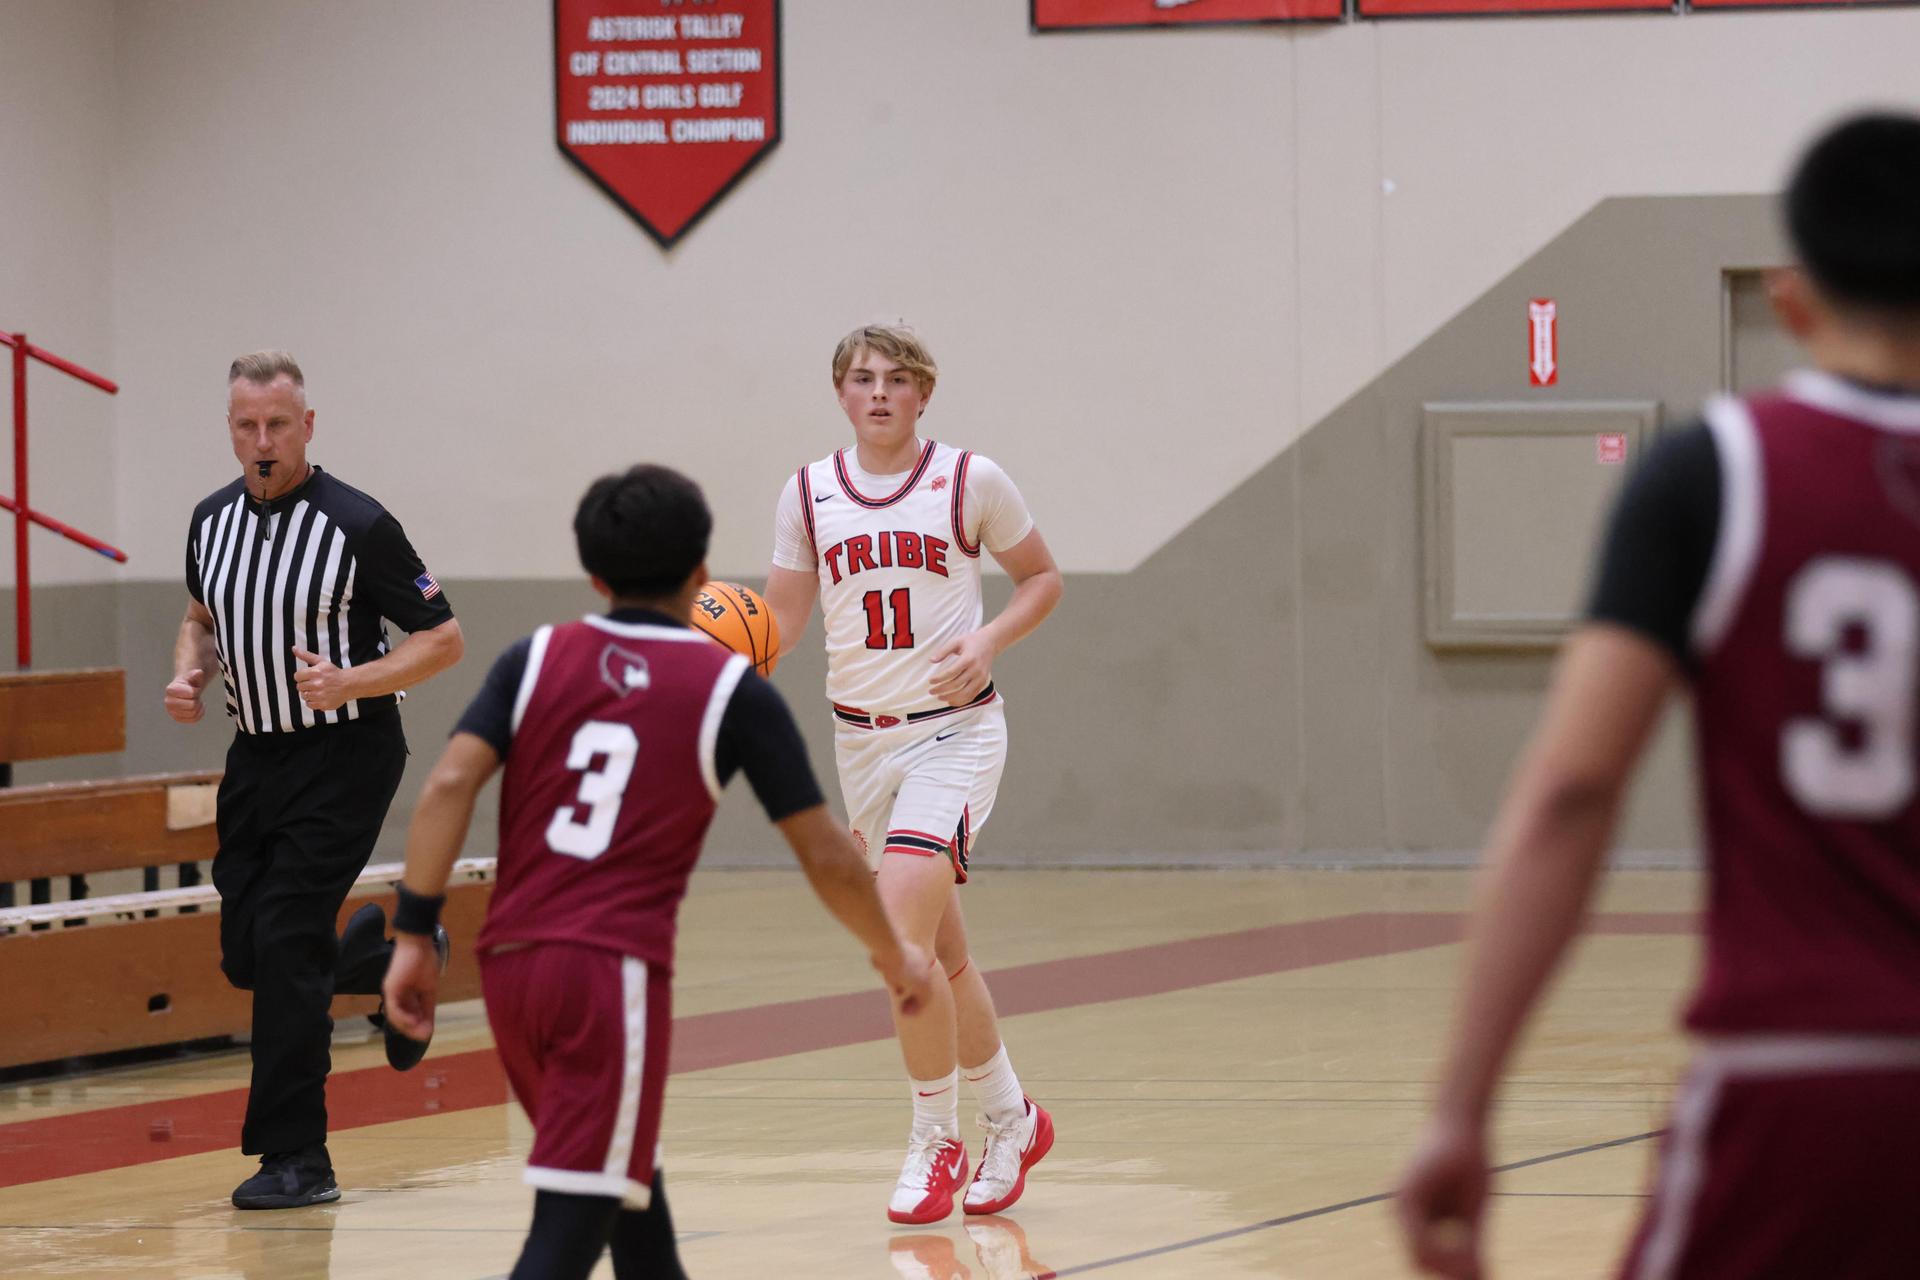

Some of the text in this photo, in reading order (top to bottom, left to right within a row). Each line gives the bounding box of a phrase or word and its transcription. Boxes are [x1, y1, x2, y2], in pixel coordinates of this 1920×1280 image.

[603, 50, 683, 75] CENTRAL
[687, 48, 761, 73] SECTION
[589, 82, 744, 110] 2024 GIRLS GOLF
[567, 118, 765, 145] INDIVIDUAL CHAMPION
[824, 531, 949, 585] TRIBE
[862, 588, 915, 650] 11
[1781, 557, 1918, 817] 3
[545, 720, 640, 861] 3
